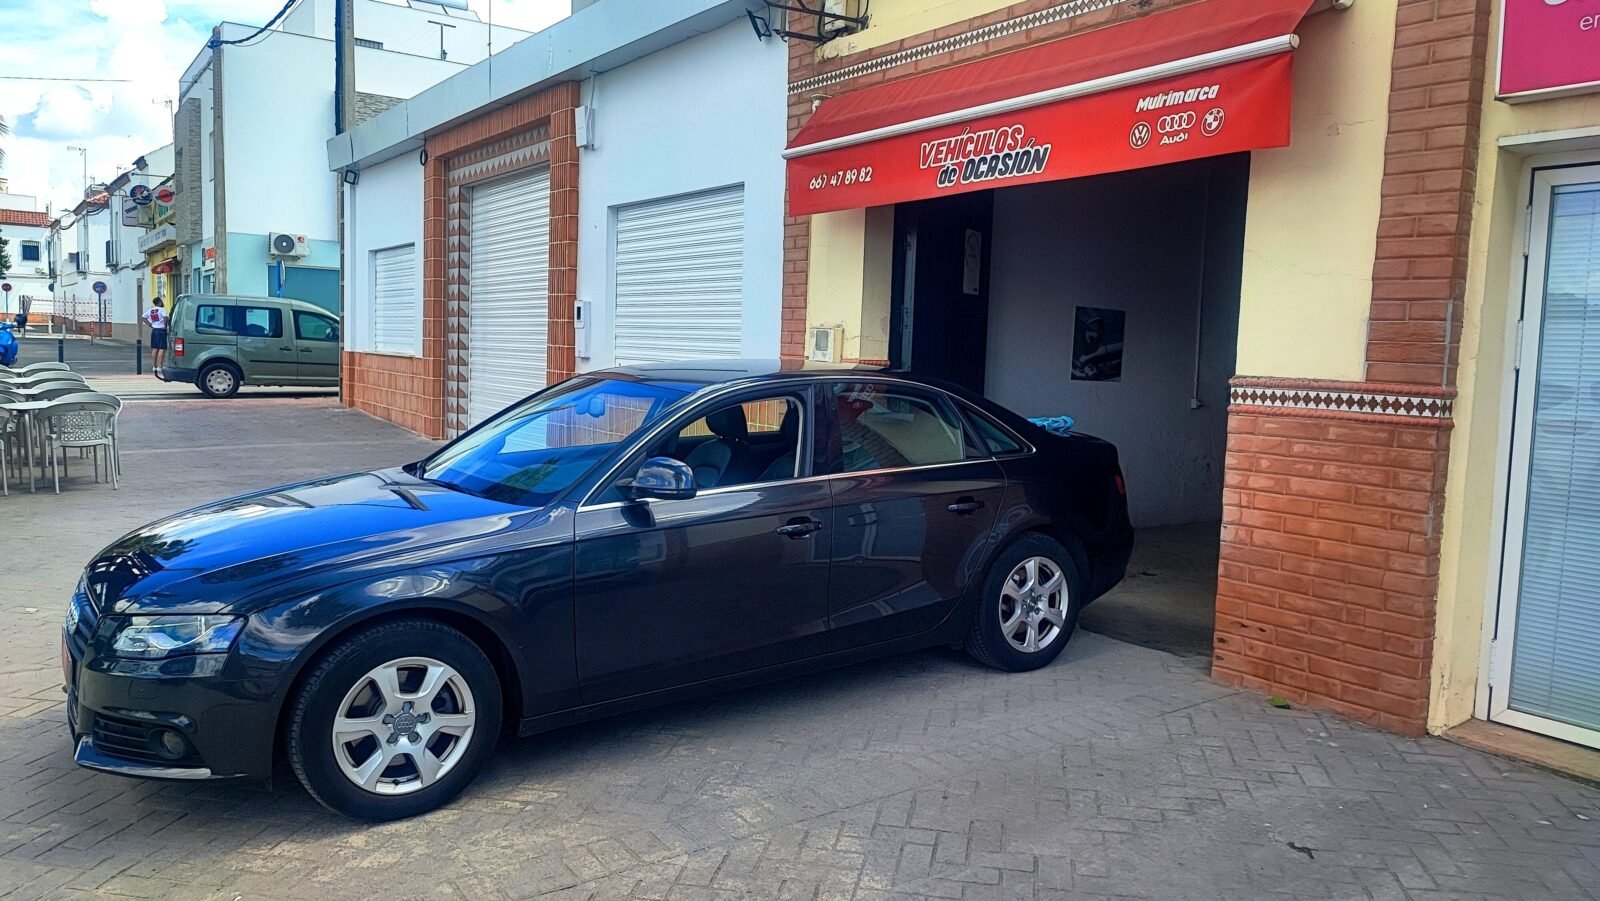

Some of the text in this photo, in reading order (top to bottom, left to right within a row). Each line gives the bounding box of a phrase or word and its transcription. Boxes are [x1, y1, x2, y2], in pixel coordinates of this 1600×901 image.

[920, 124, 1024, 169] VEHÍCULOS
[1159, 132, 1189, 146] Audi
[829, 170, 844, 187] 47
[844, 168, 858, 185] 89
[859, 166, 873, 183] 82
[937, 138, 1052, 188] de OCASIÓN
